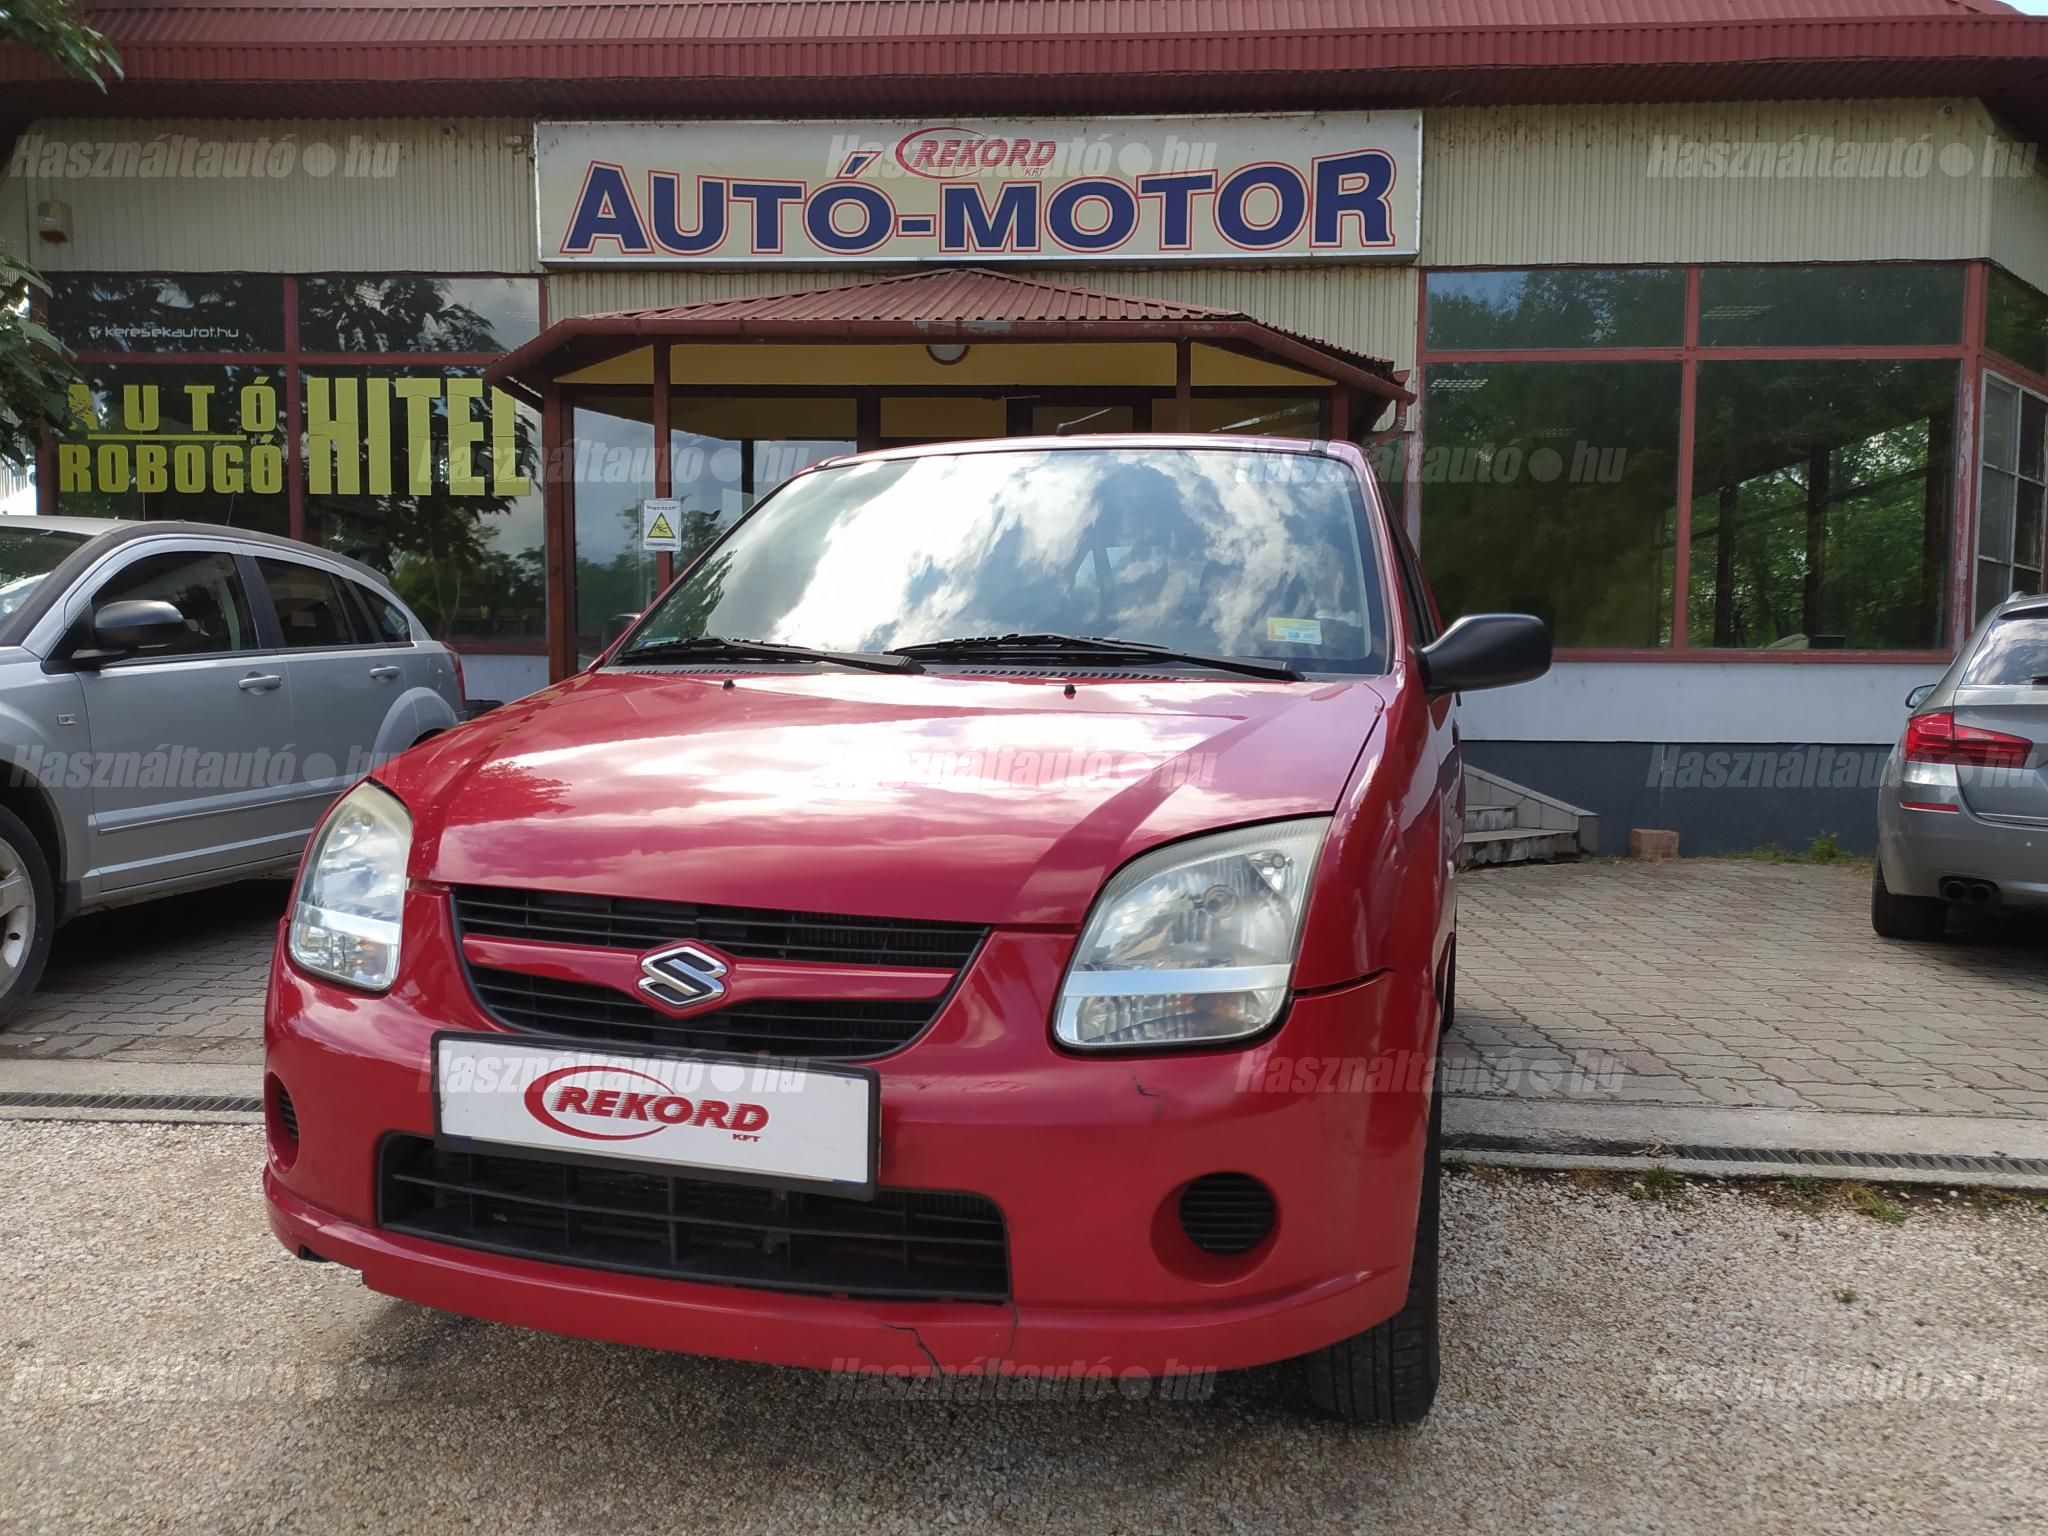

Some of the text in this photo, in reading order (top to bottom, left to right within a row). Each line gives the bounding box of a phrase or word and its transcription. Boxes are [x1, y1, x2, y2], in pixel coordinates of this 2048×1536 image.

[912, 139, 1056, 167] REKORD
[1024, 168, 1045, 176] KFT
[559, 149, 1397, 256] AUTÓ-MOTOR
[105, 326, 239, 338] keresekautot.hu
[68, 376, 276, 431] AUTÓ
[307, 377, 531, 496] HITEL
[59, 434, 282, 494] ROBOGÓ
[549, 1086, 769, 1132] REKORD
[732, 1133, 761, 1142] KFT
